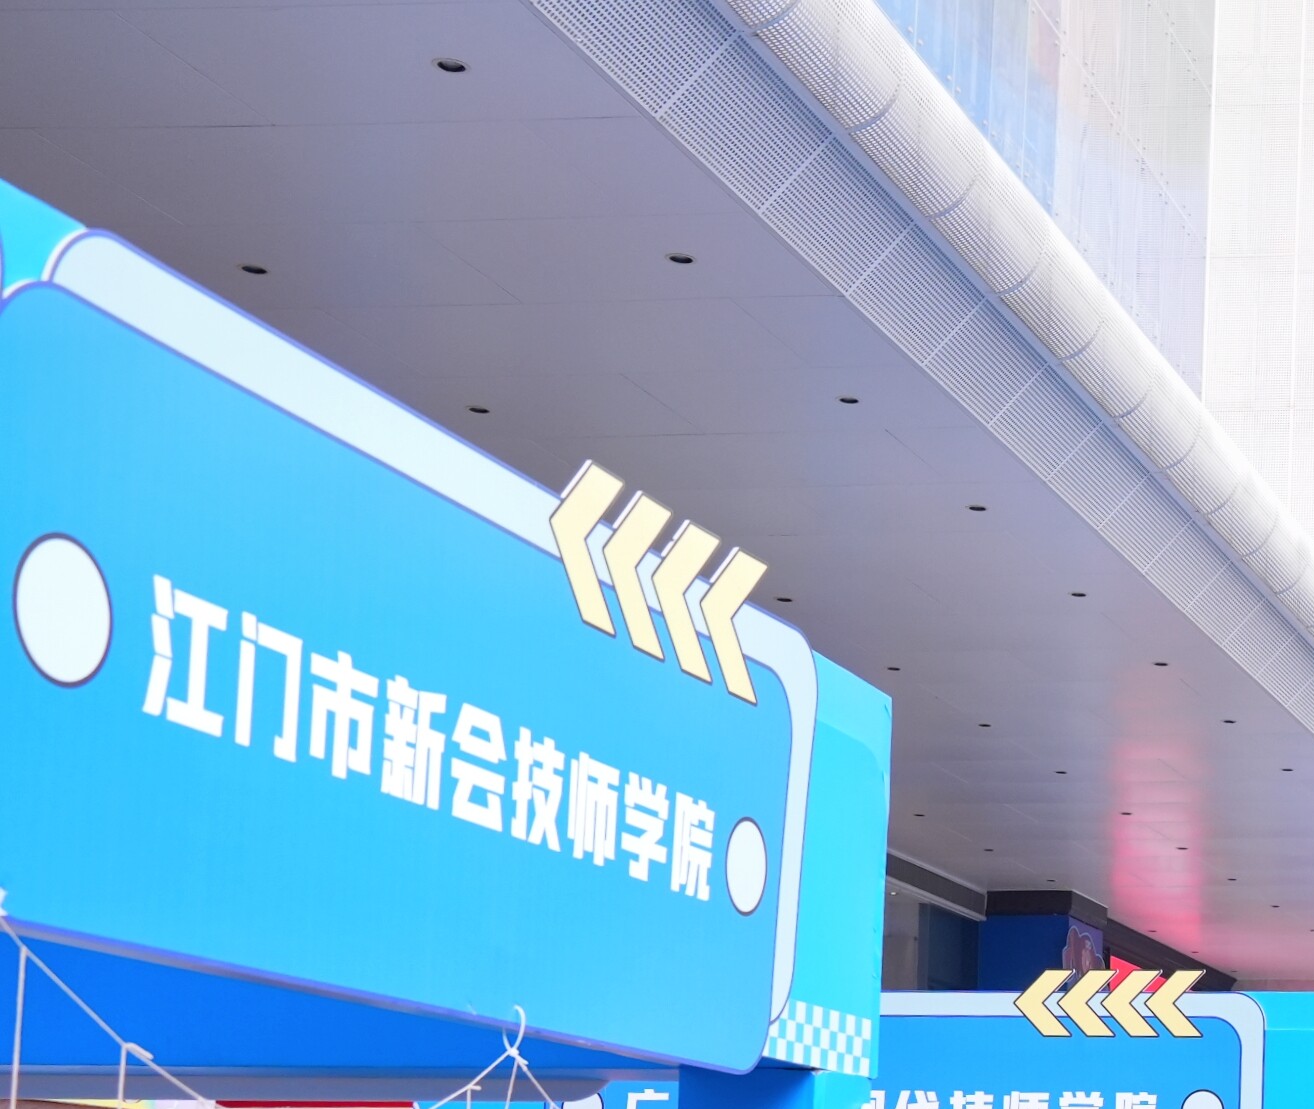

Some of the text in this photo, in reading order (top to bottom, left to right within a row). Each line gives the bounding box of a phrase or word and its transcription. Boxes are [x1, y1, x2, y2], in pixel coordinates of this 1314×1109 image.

[143, 574, 716, 902] 江门市新会技师学院
